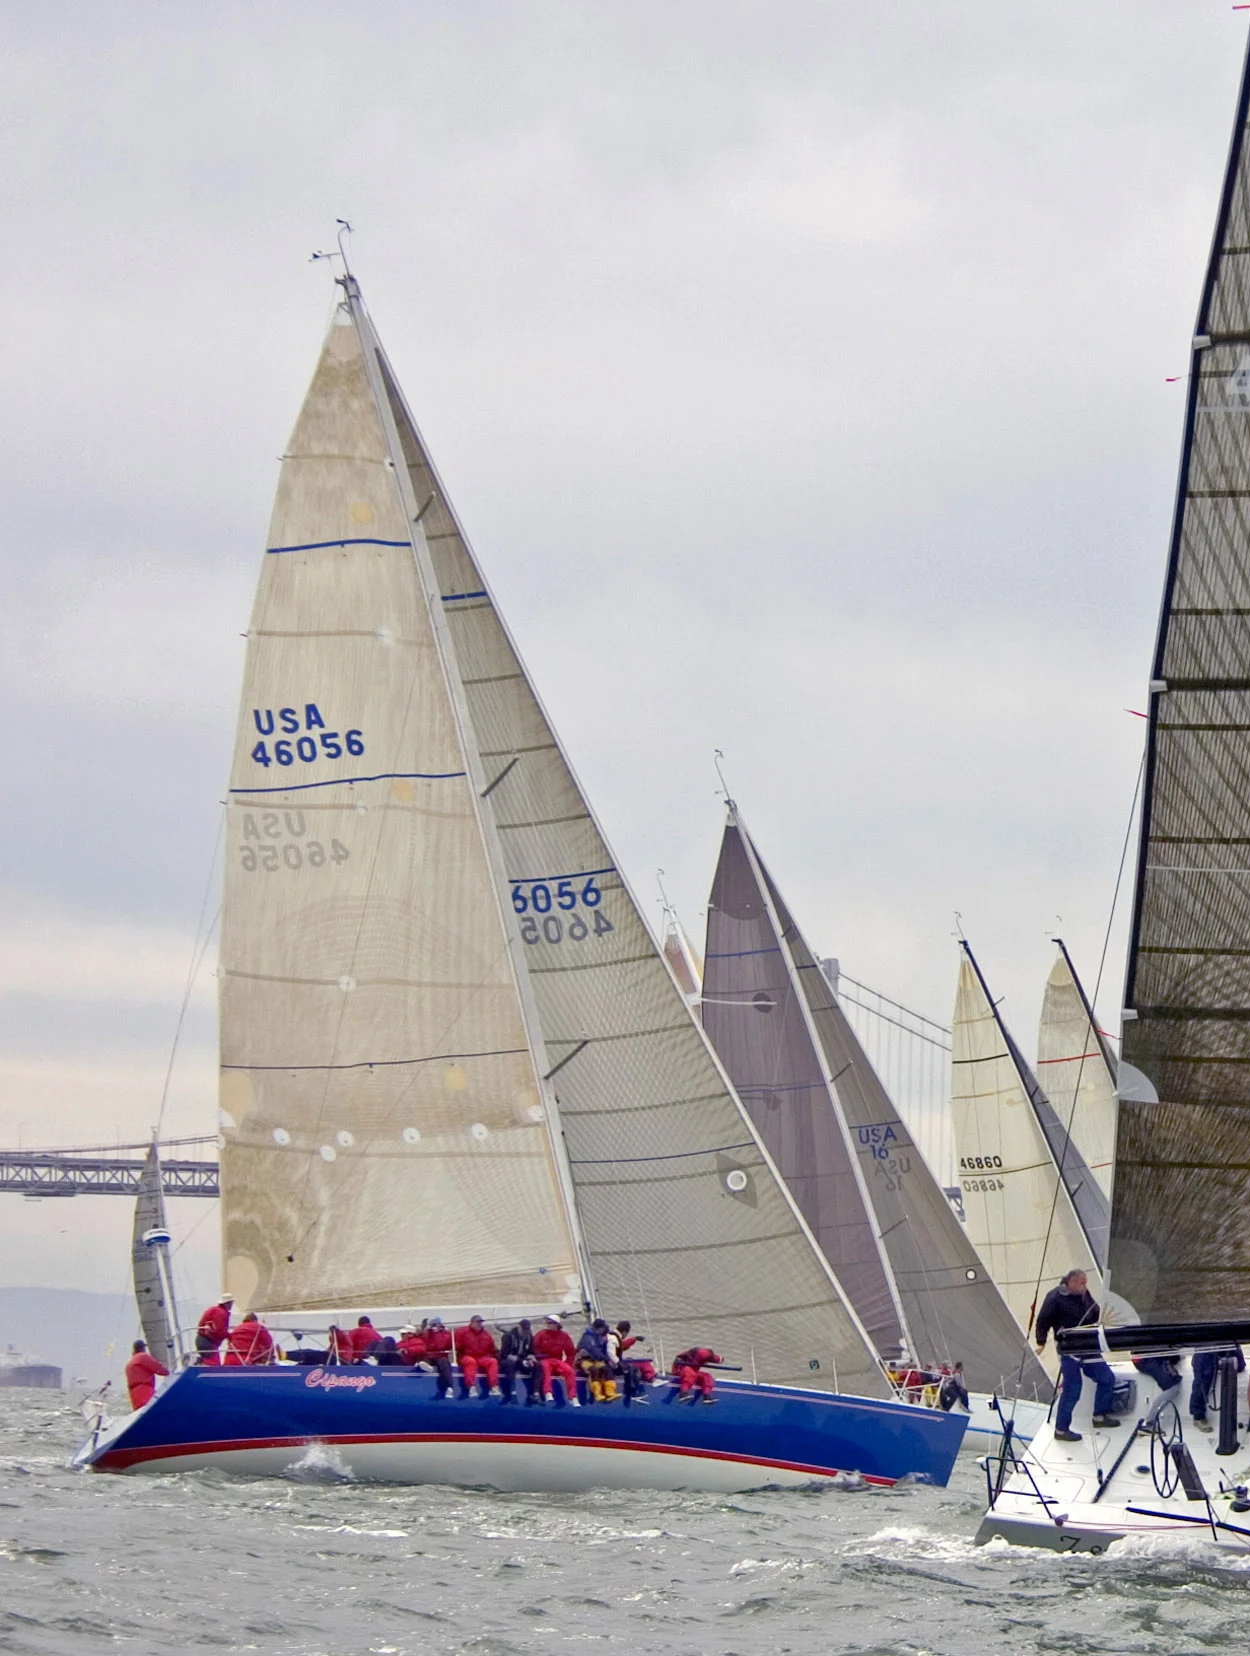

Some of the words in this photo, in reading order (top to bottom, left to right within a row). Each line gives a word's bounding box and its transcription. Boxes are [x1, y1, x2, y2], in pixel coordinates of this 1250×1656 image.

[253, 703, 325, 735] USA
[252, 730, 364, 767] 46056
[512, 877, 601, 913] 6056
[858, 1126, 897, 1144] USA
[869, 1143, 889, 1160] 16
[960, 1155, 1002, 1169] 46860
